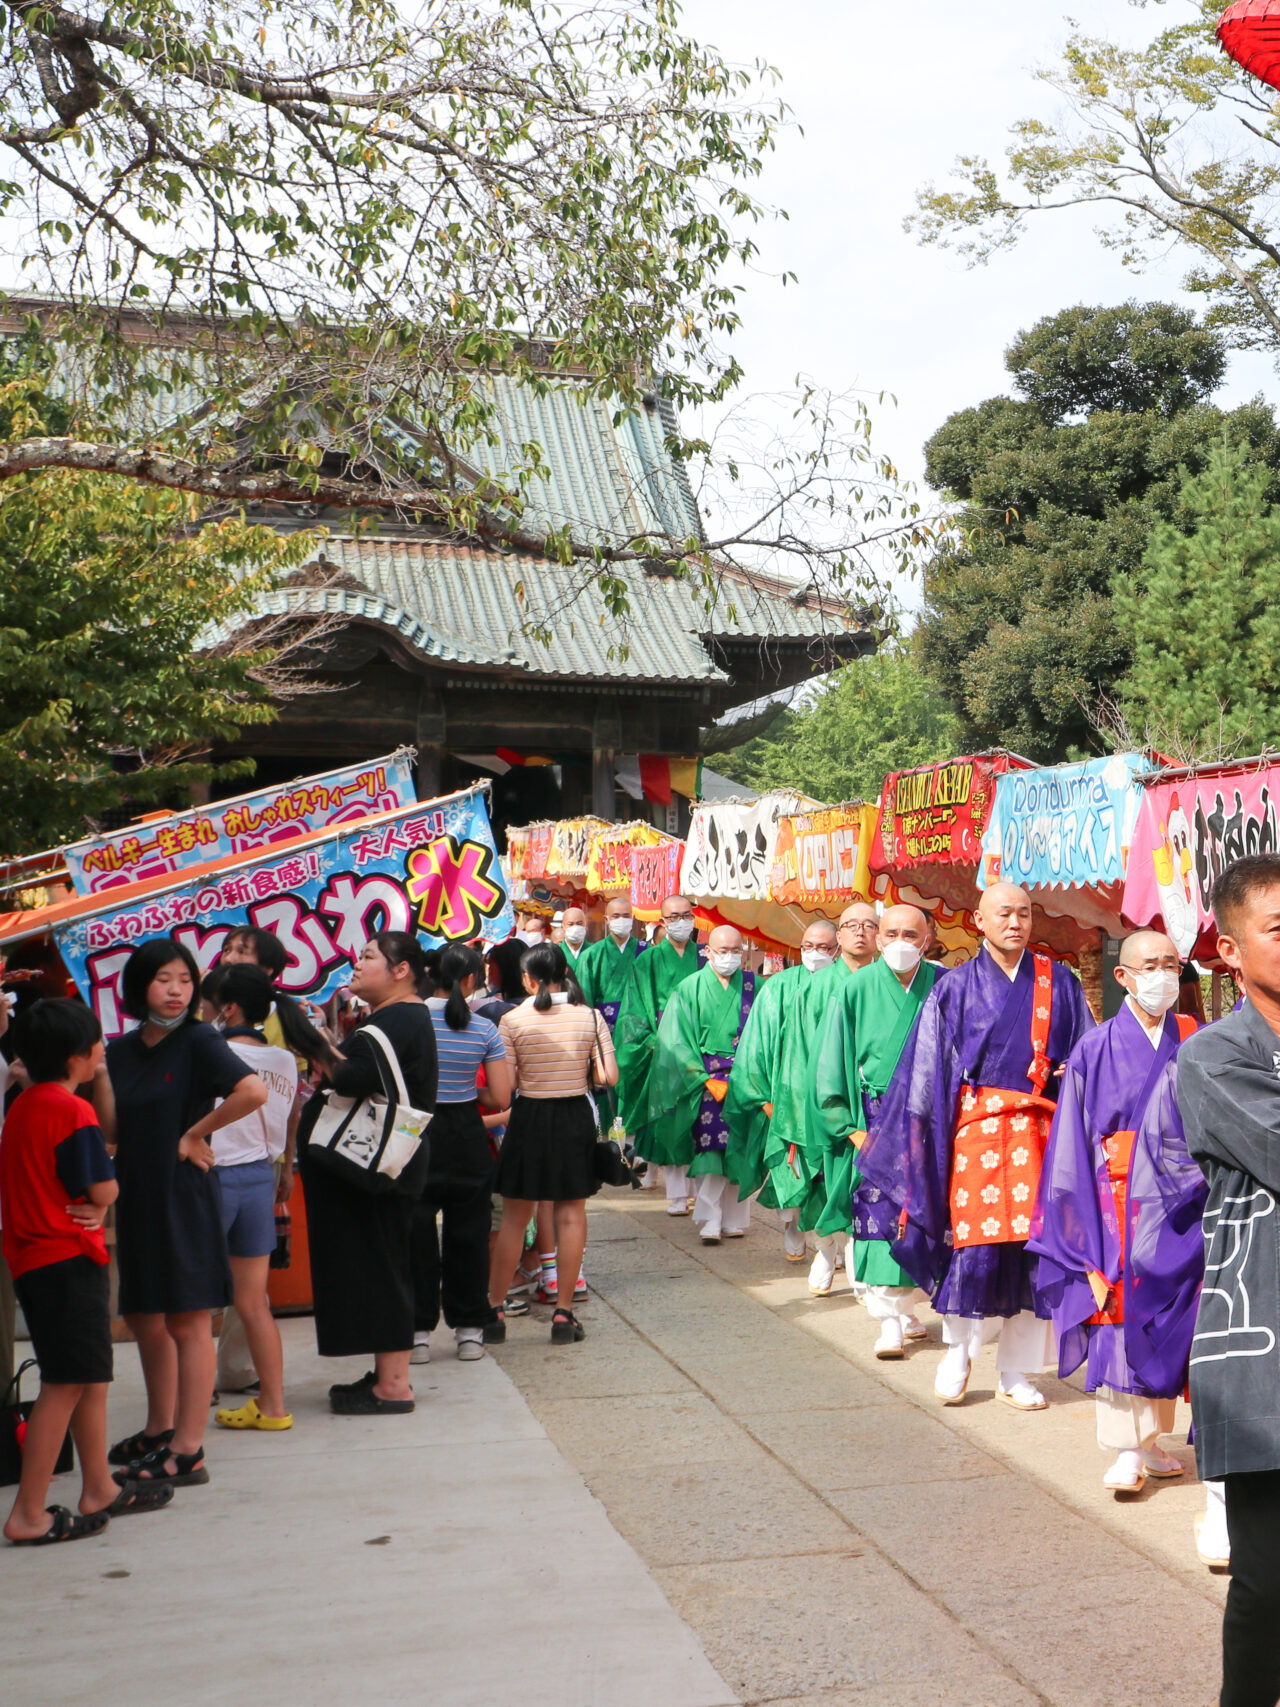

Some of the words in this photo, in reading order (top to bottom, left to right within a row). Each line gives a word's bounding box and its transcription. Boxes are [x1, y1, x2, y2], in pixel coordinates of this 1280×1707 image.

[1013, 775, 1109, 814] Dondurma
[81, 818, 218, 874] ベルギー生まれ
[349, 810, 446, 866] 大人気！
[86, 852, 321, 949] ふわふわの新食感！
[406, 836, 502, 940] 氷
